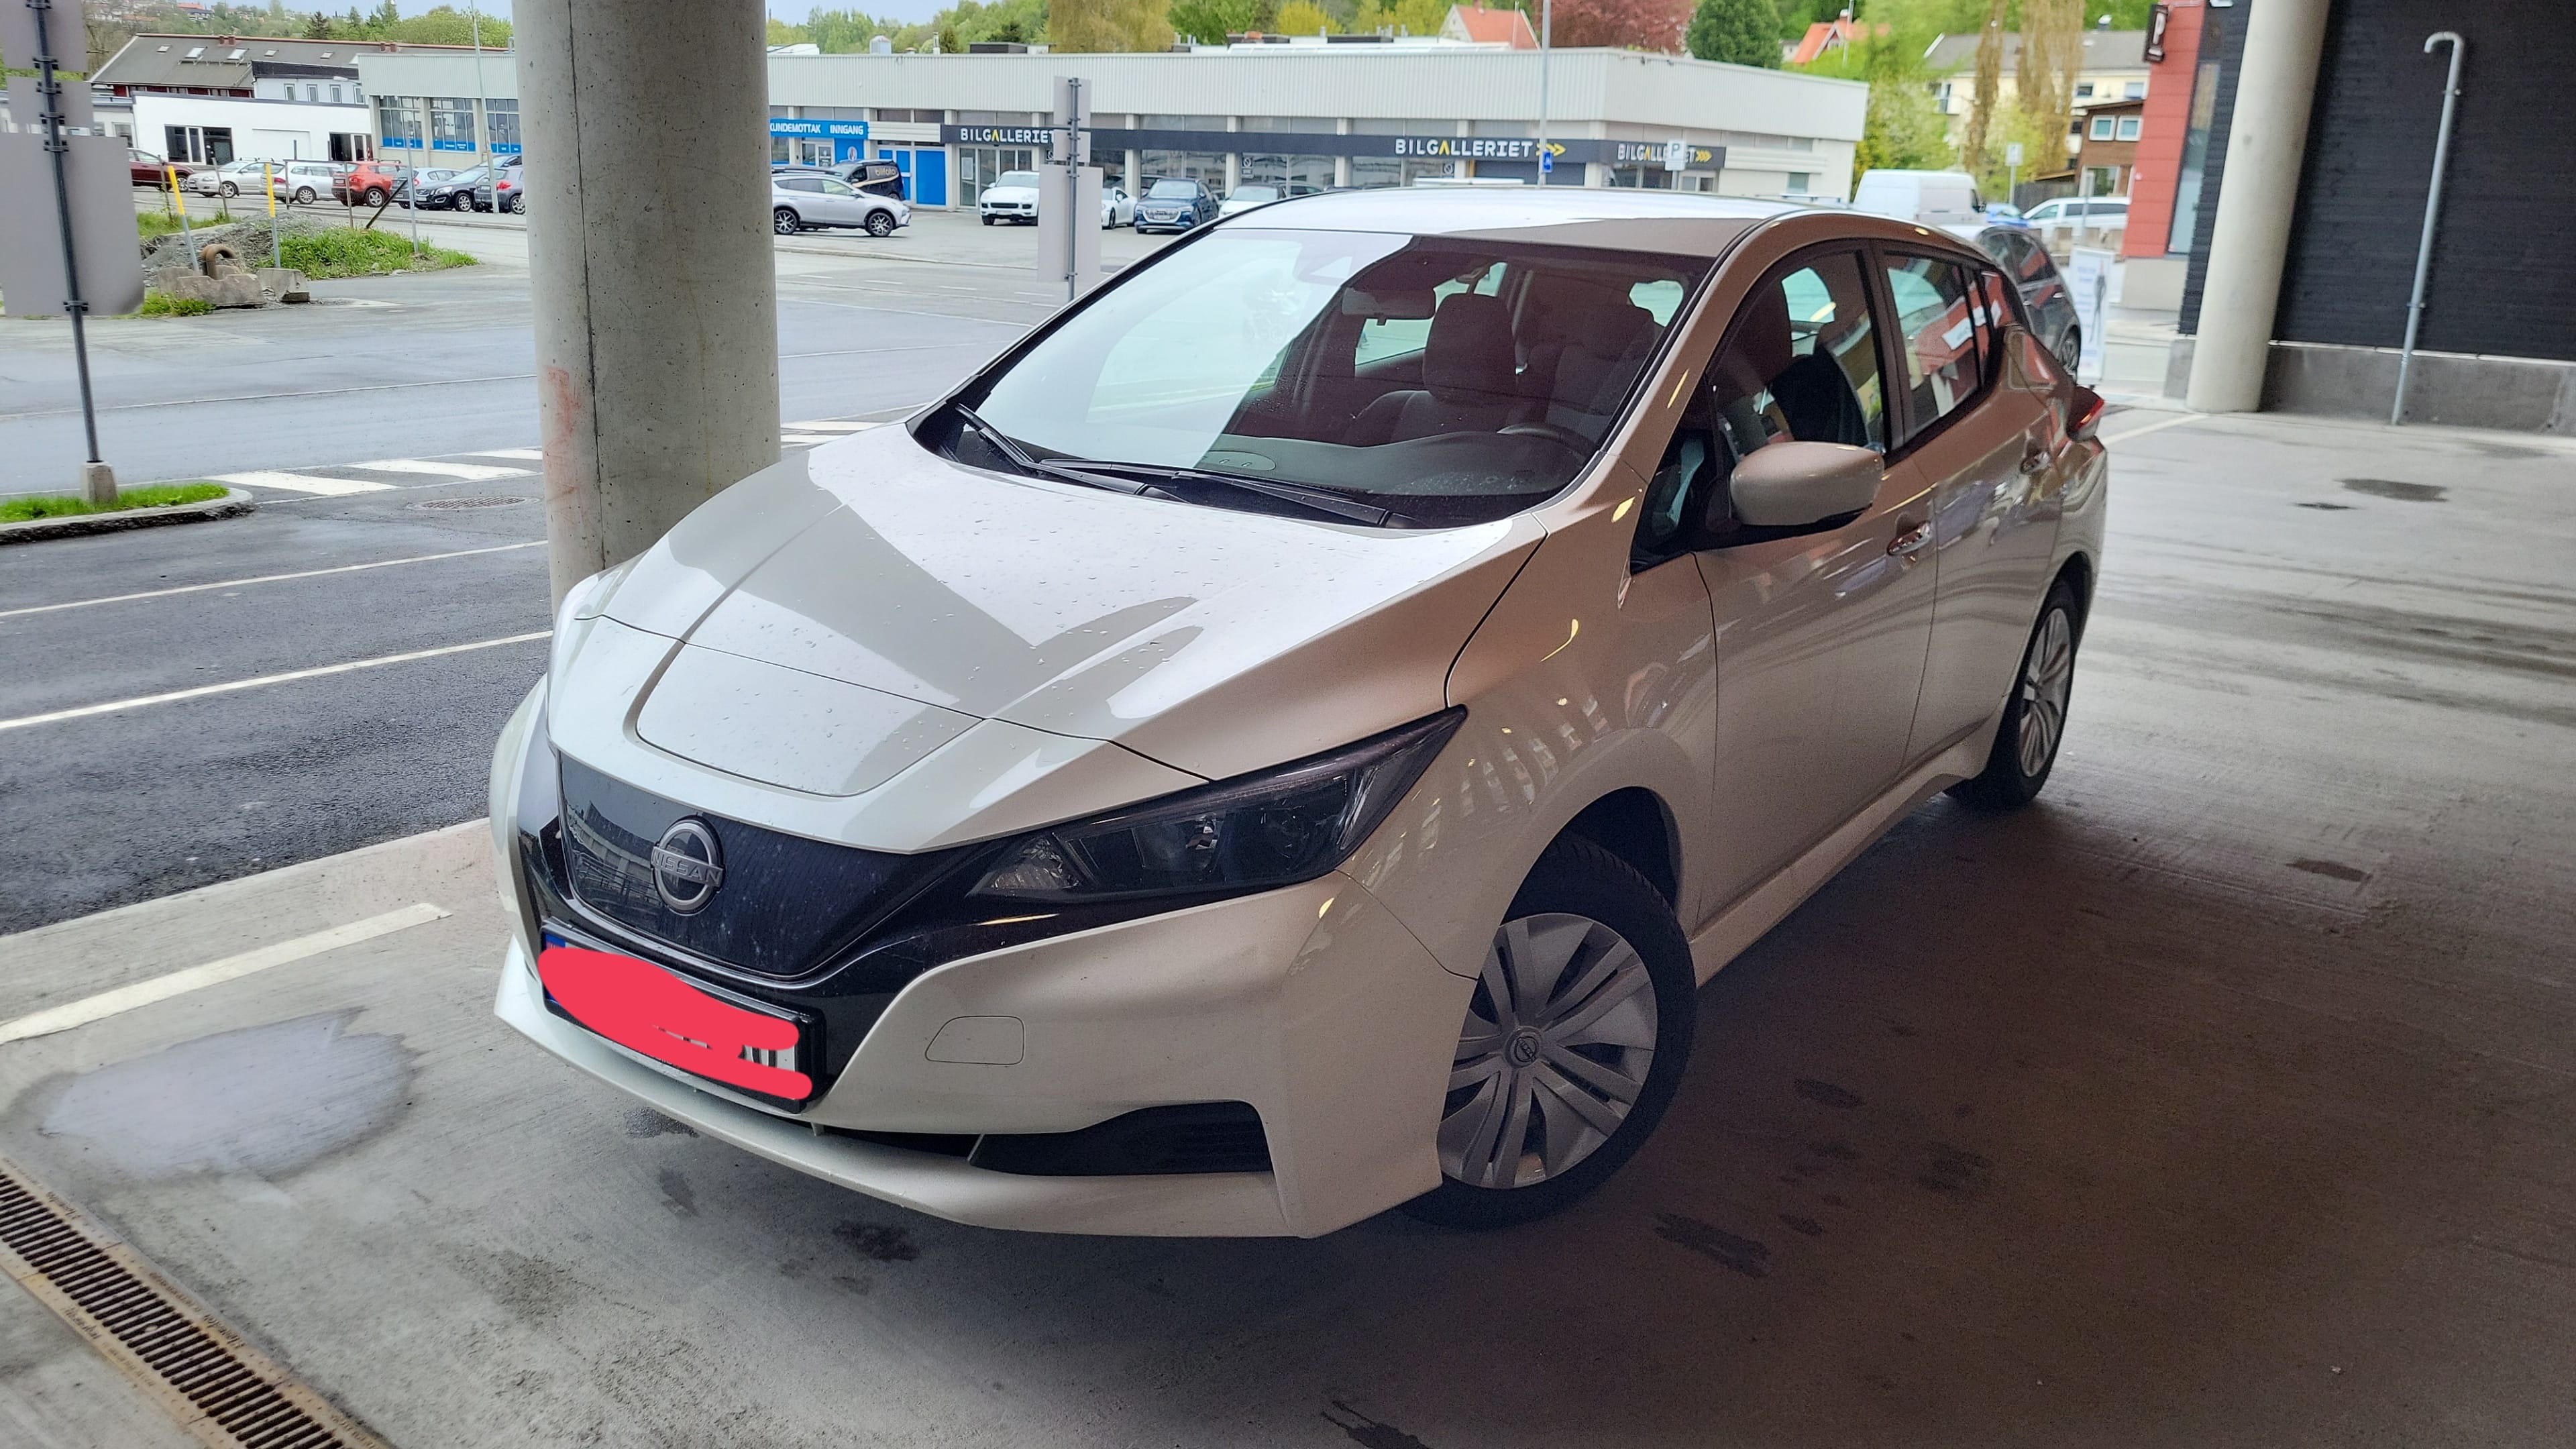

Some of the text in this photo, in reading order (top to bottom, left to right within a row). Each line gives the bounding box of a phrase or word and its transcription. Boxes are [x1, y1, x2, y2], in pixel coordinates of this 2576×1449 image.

[2153, 12, 2166, 44] P
[830, 125, 864, 135] INNGANG
[1395, 138, 1534, 158] BILGALLERIET
[1672, 143, 1680, 156] P
[651, 851, 722, 886] NISSAN
